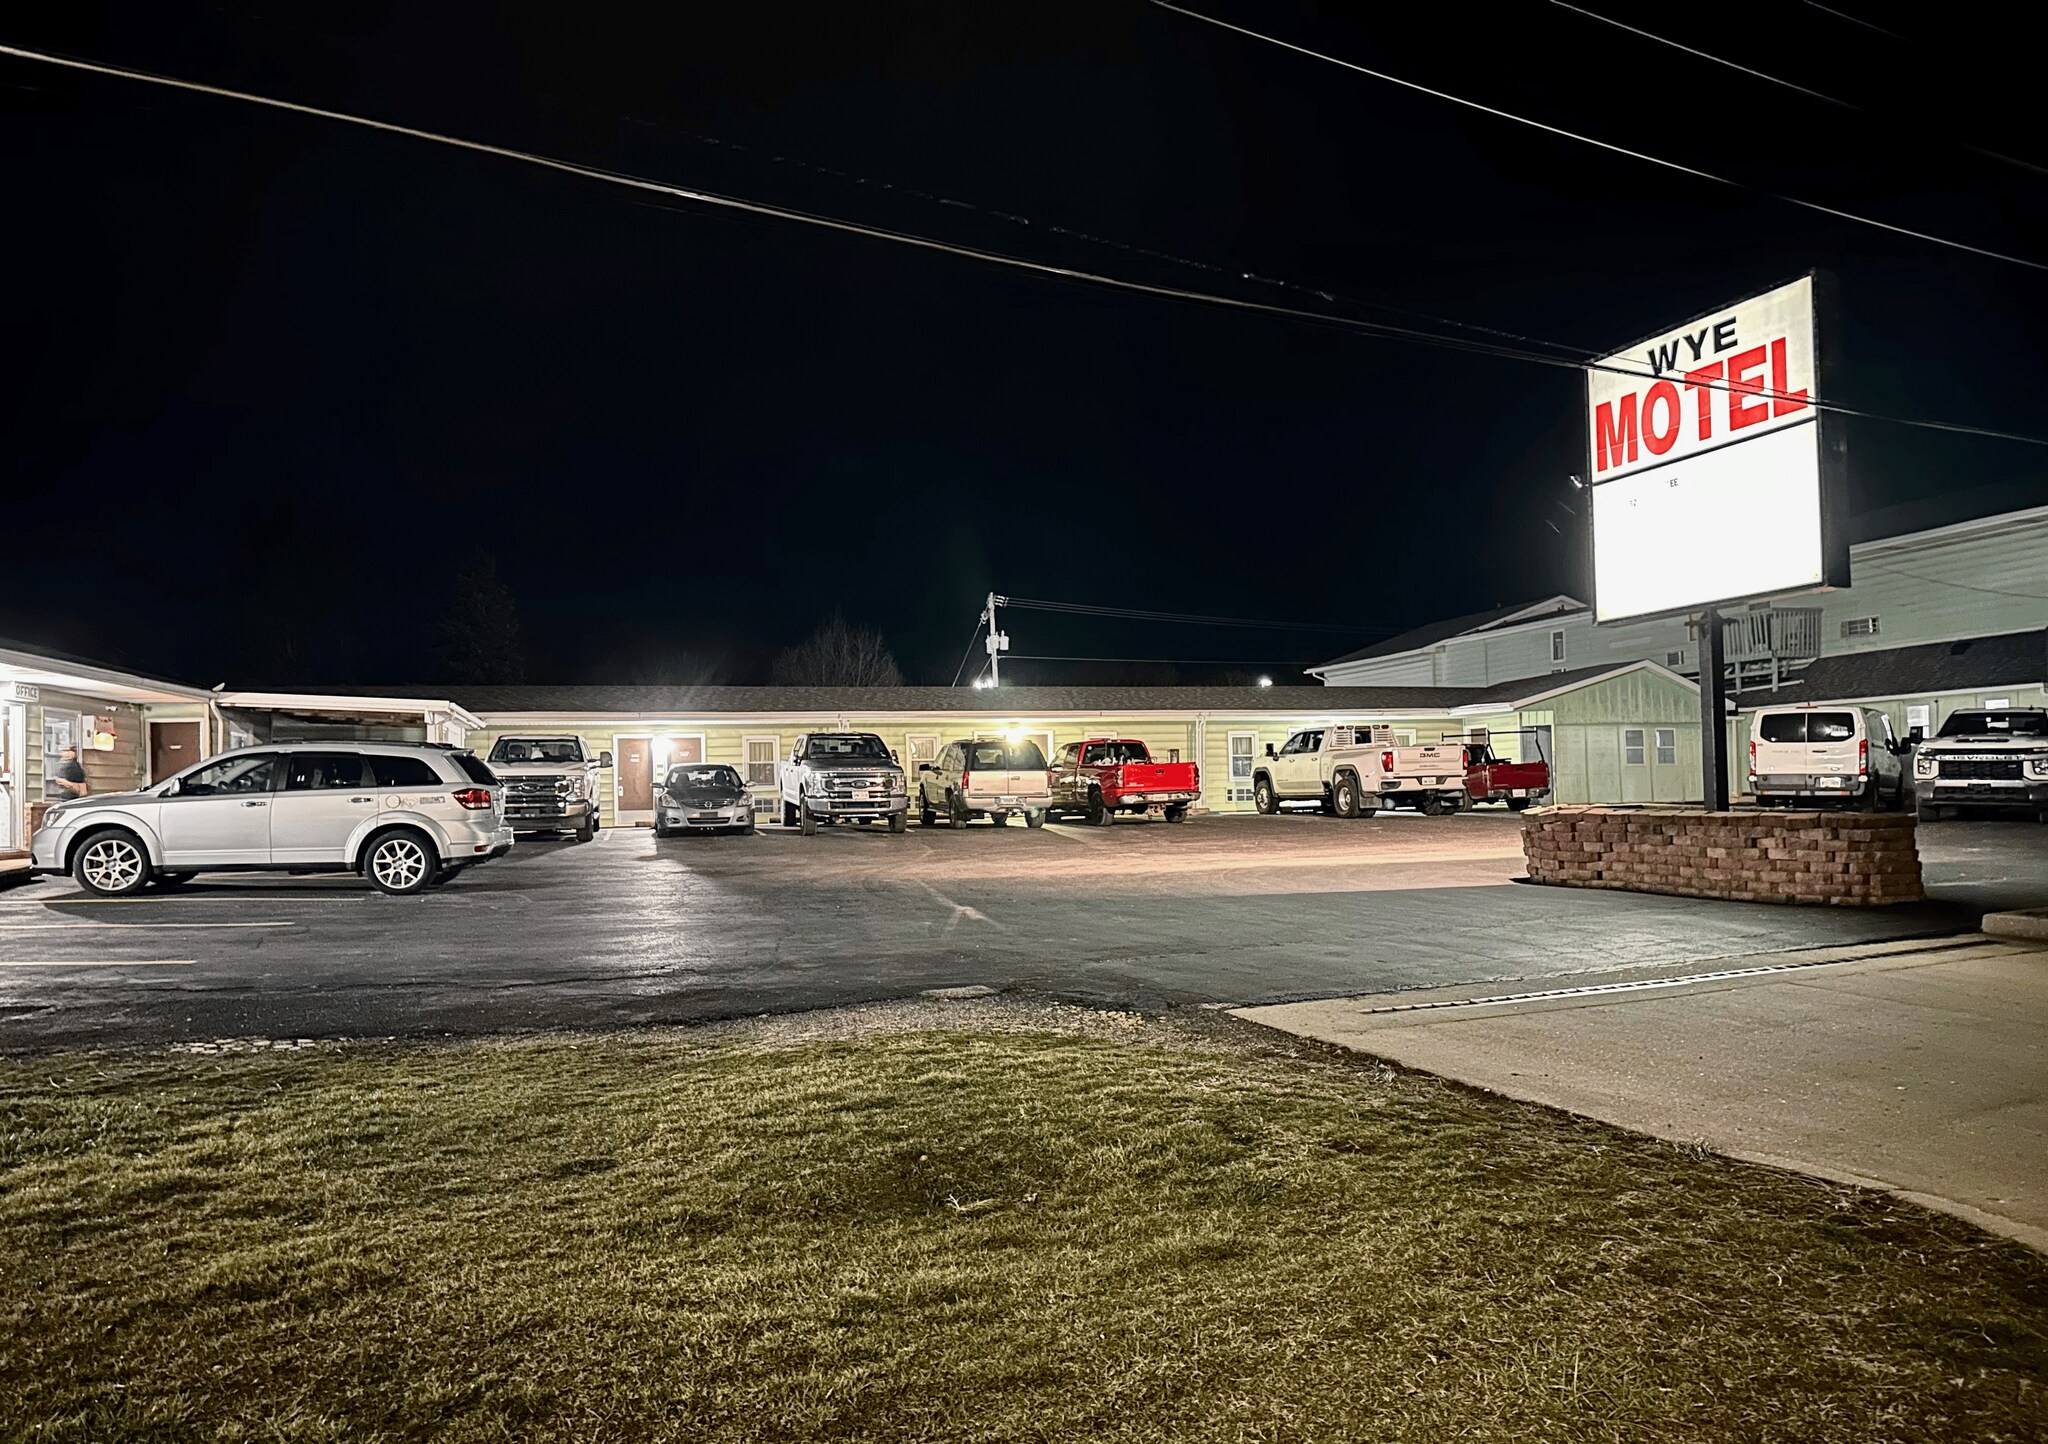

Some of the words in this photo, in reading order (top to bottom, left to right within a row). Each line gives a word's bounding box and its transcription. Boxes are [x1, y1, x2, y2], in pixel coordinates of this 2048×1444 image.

[1647, 316, 1738, 376] WYE
[1596, 337, 1808, 472] MOTEL
[16, 685, 37, 697] OFFICE
